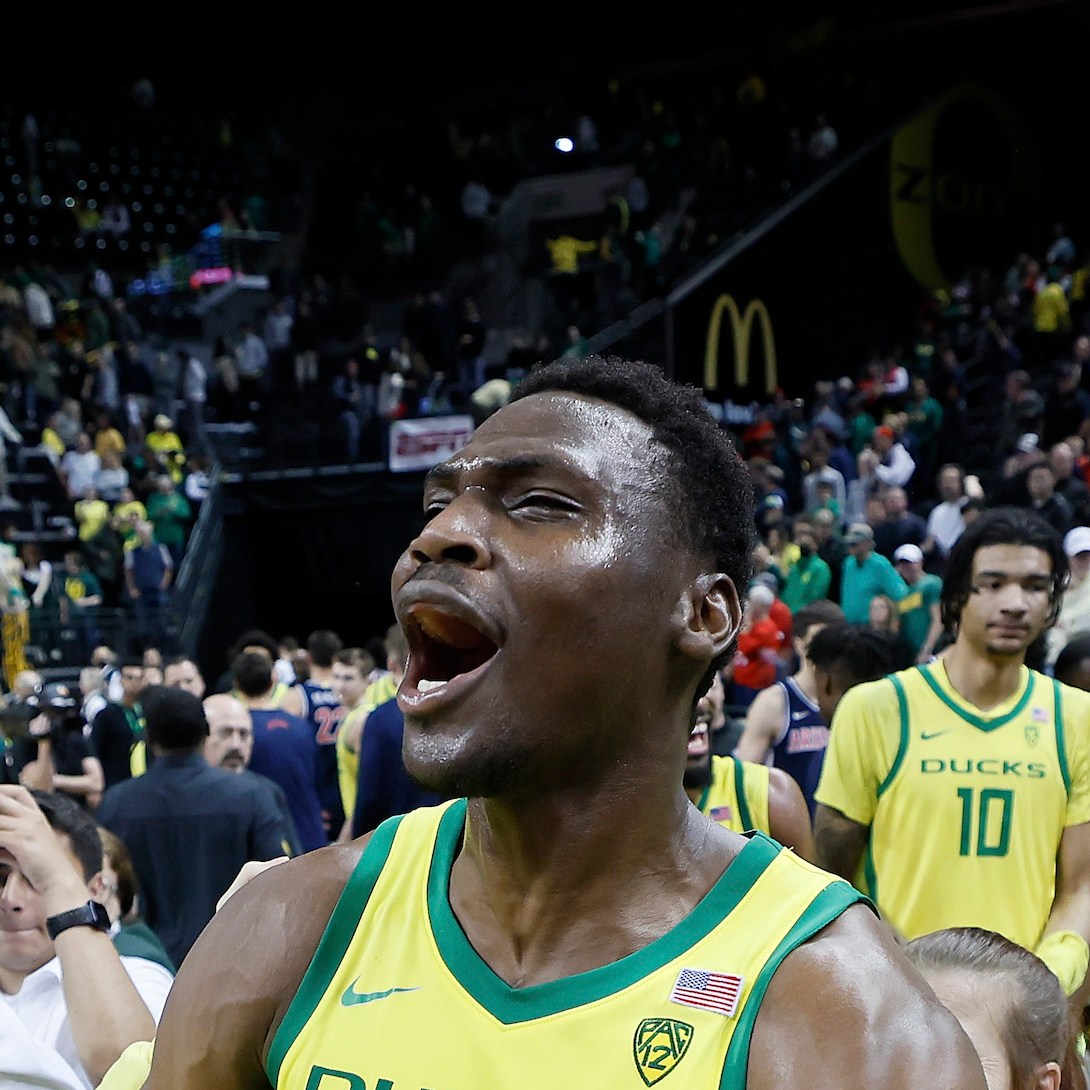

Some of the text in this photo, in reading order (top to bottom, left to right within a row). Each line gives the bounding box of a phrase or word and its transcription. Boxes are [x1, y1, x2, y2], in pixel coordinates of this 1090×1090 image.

[920, 758, 1047, 779] DUCKS
[957, 787, 1015, 857] 10
[638, 1021, 691, 1060] PAC
[641, 1044, 668, 1071] 12
